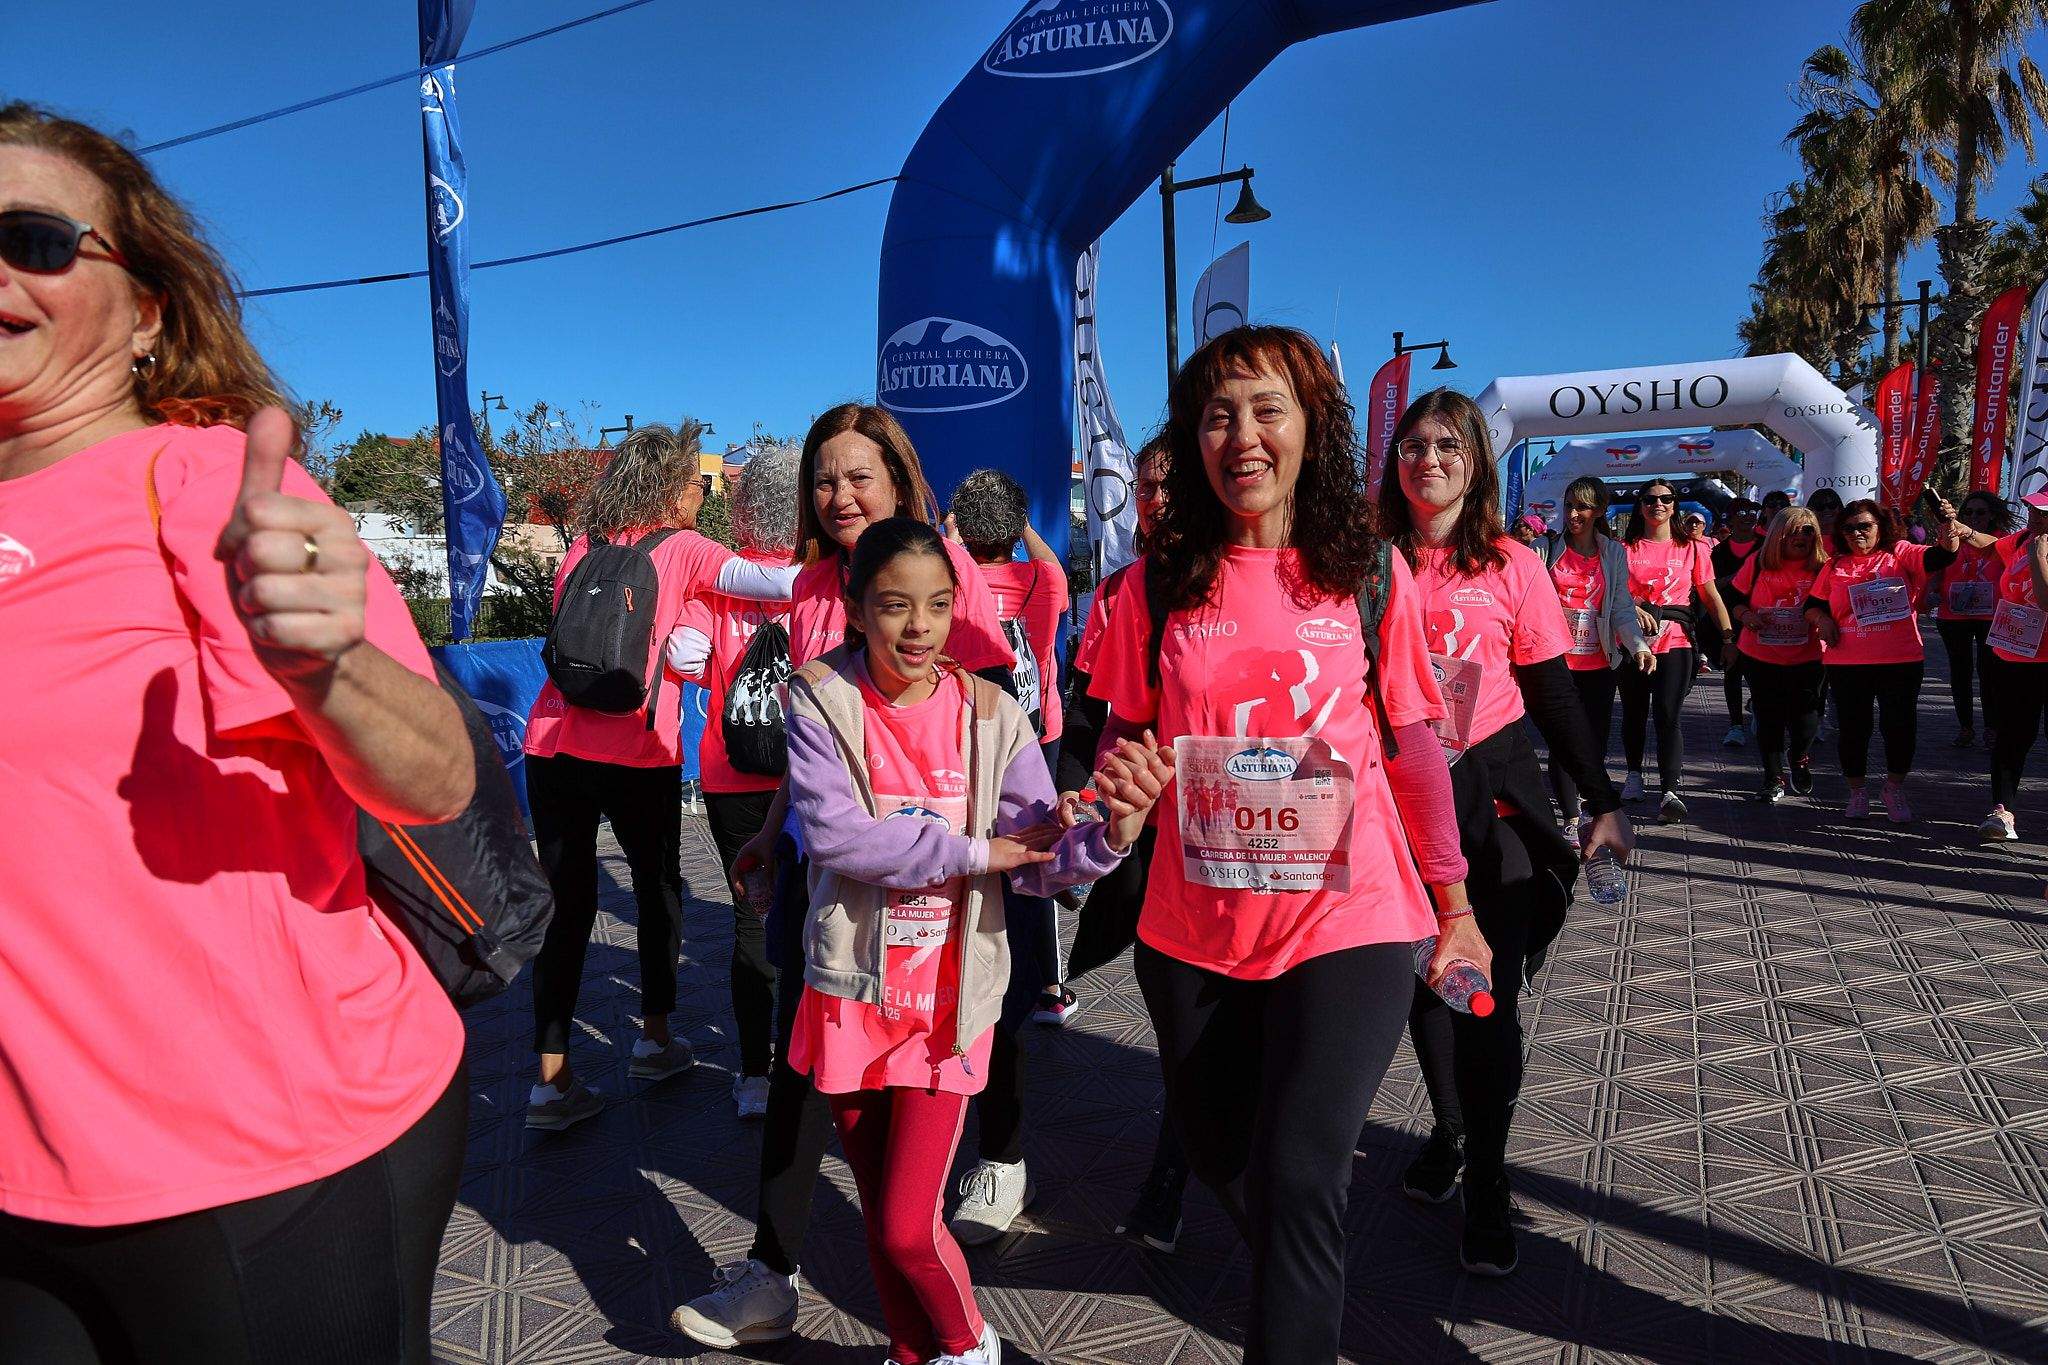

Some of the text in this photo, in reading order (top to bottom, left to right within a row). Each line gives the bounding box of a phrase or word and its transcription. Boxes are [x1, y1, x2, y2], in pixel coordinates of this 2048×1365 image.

[1022, 3, 1150, 32] CENTRAL LECHERA
[992, 16, 1158, 67] ASTURIANA
[893, 349, 1010, 363] CENTRAL LECHERA
[880, 358, 1015, 393] ASTURIANA
[1984, 321, 2010, 433] Santander
[1549, 374, 1729, 419] OYSHO
[1784, 402, 1843, 418] OYSHO
[1888, 389, 1902, 466] Santander
[1815, 474, 1871, 488] OYSHO
[1570, 629, 1590, 637] 016
[1231, 759, 1293, 773] ASTURIANA
[1234, 806, 1299, 832] 016
[1247, 838, 1279, 849] 4252
[1200, 849, 1331, 861] CARRERA DE LA MUJER VALENCIA
[1199, 865, 1249, 879] OYSHO
[1283, 870, 1335, 881] Santander
[898, 895, 928, 906] 4254
[897, 909, 907, 917] LA
[908, 910, 935, 919] MUJER
[896, 988, 912, 1008] LA
